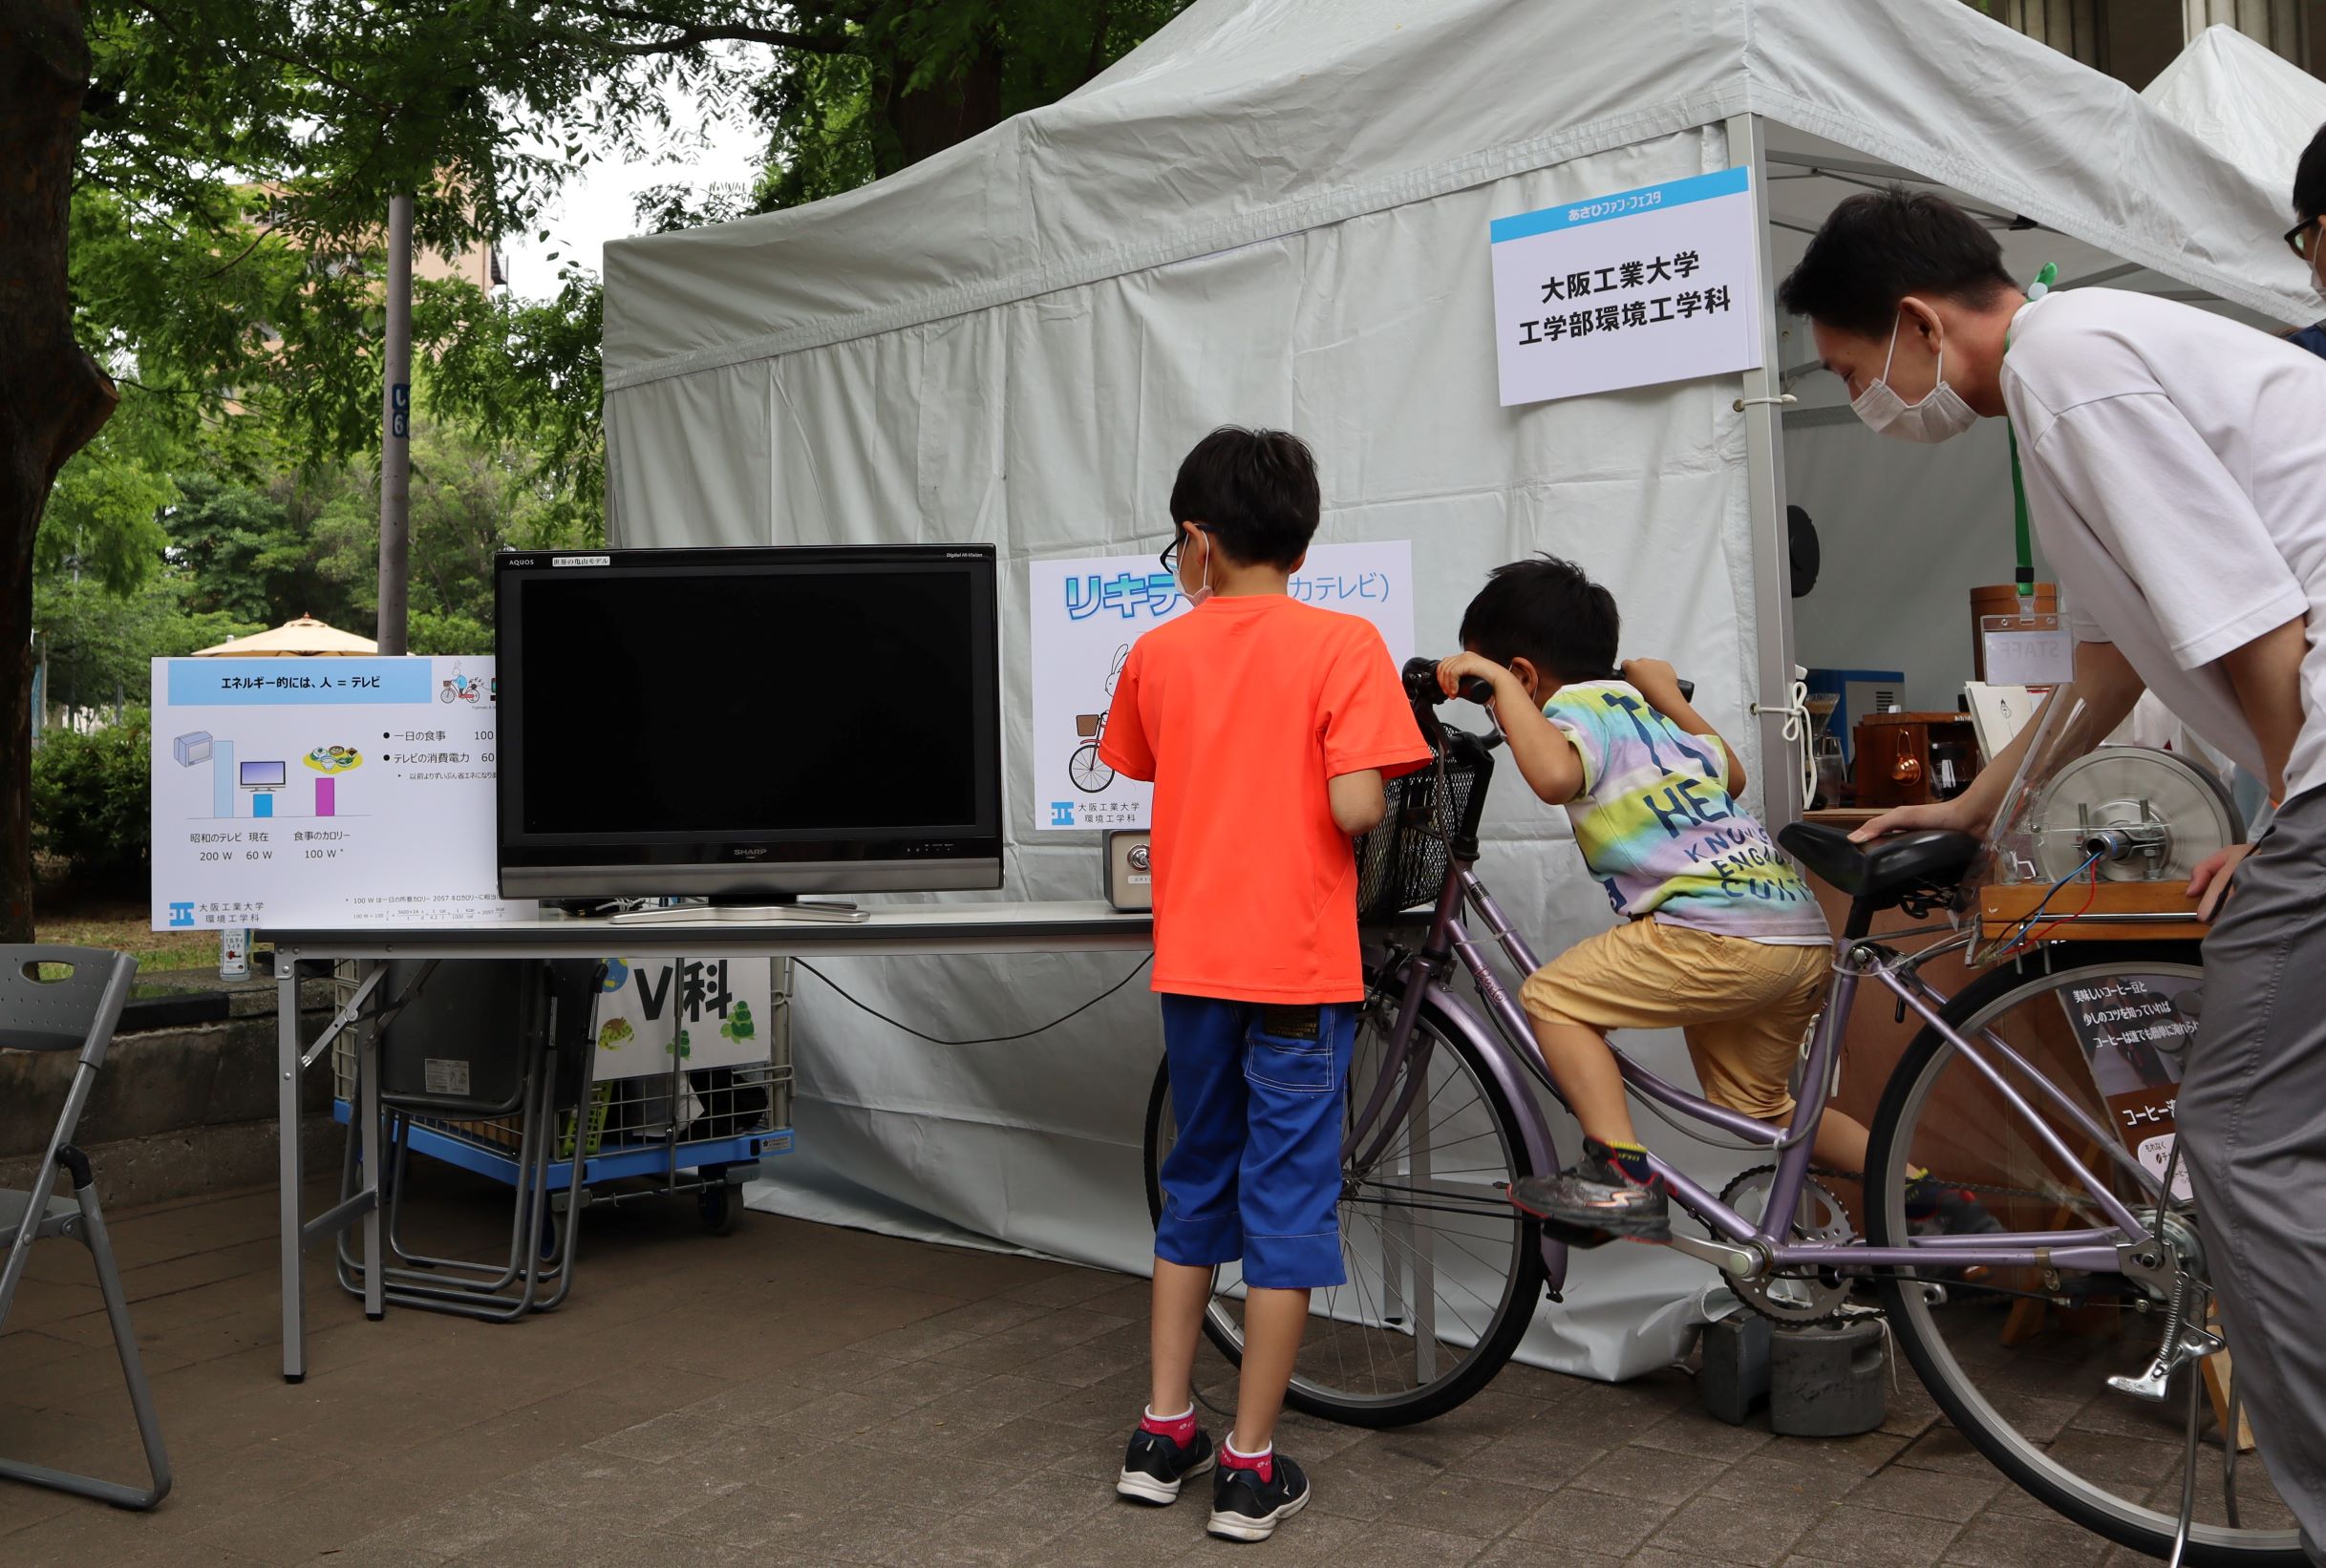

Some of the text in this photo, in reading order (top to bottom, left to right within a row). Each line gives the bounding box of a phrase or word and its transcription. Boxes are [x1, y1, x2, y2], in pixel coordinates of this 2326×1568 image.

[1541, 250, 1699, 304] 大阪工業大学
[1519, 285, 1731, 346] 工学部環境工学科
[351, 675, 380, 688] テレビ
[394, 731, 494, 741] 一日の食事 100
[394, 752, 495, 764] テレビの消費電力 60
[1078, 802, 1140, 812] 大阪工業大学
[1084, 814, 1136, 823] 環境工学科
[190, 831, 351, 843] 昭和のテレビ 現在 食事のカロリー
[200, 850, 337, 861] 200 W 60 W 100 W
[199, 901, 265, 912] 大阪工業大学
[205, 914, 259, 923] 環境工学科
[2072, 981, 2148, 1003] 美味しいコーヒー豆と
[2083, 1000, 2171, 1027] 少しのコツを知っていれば
